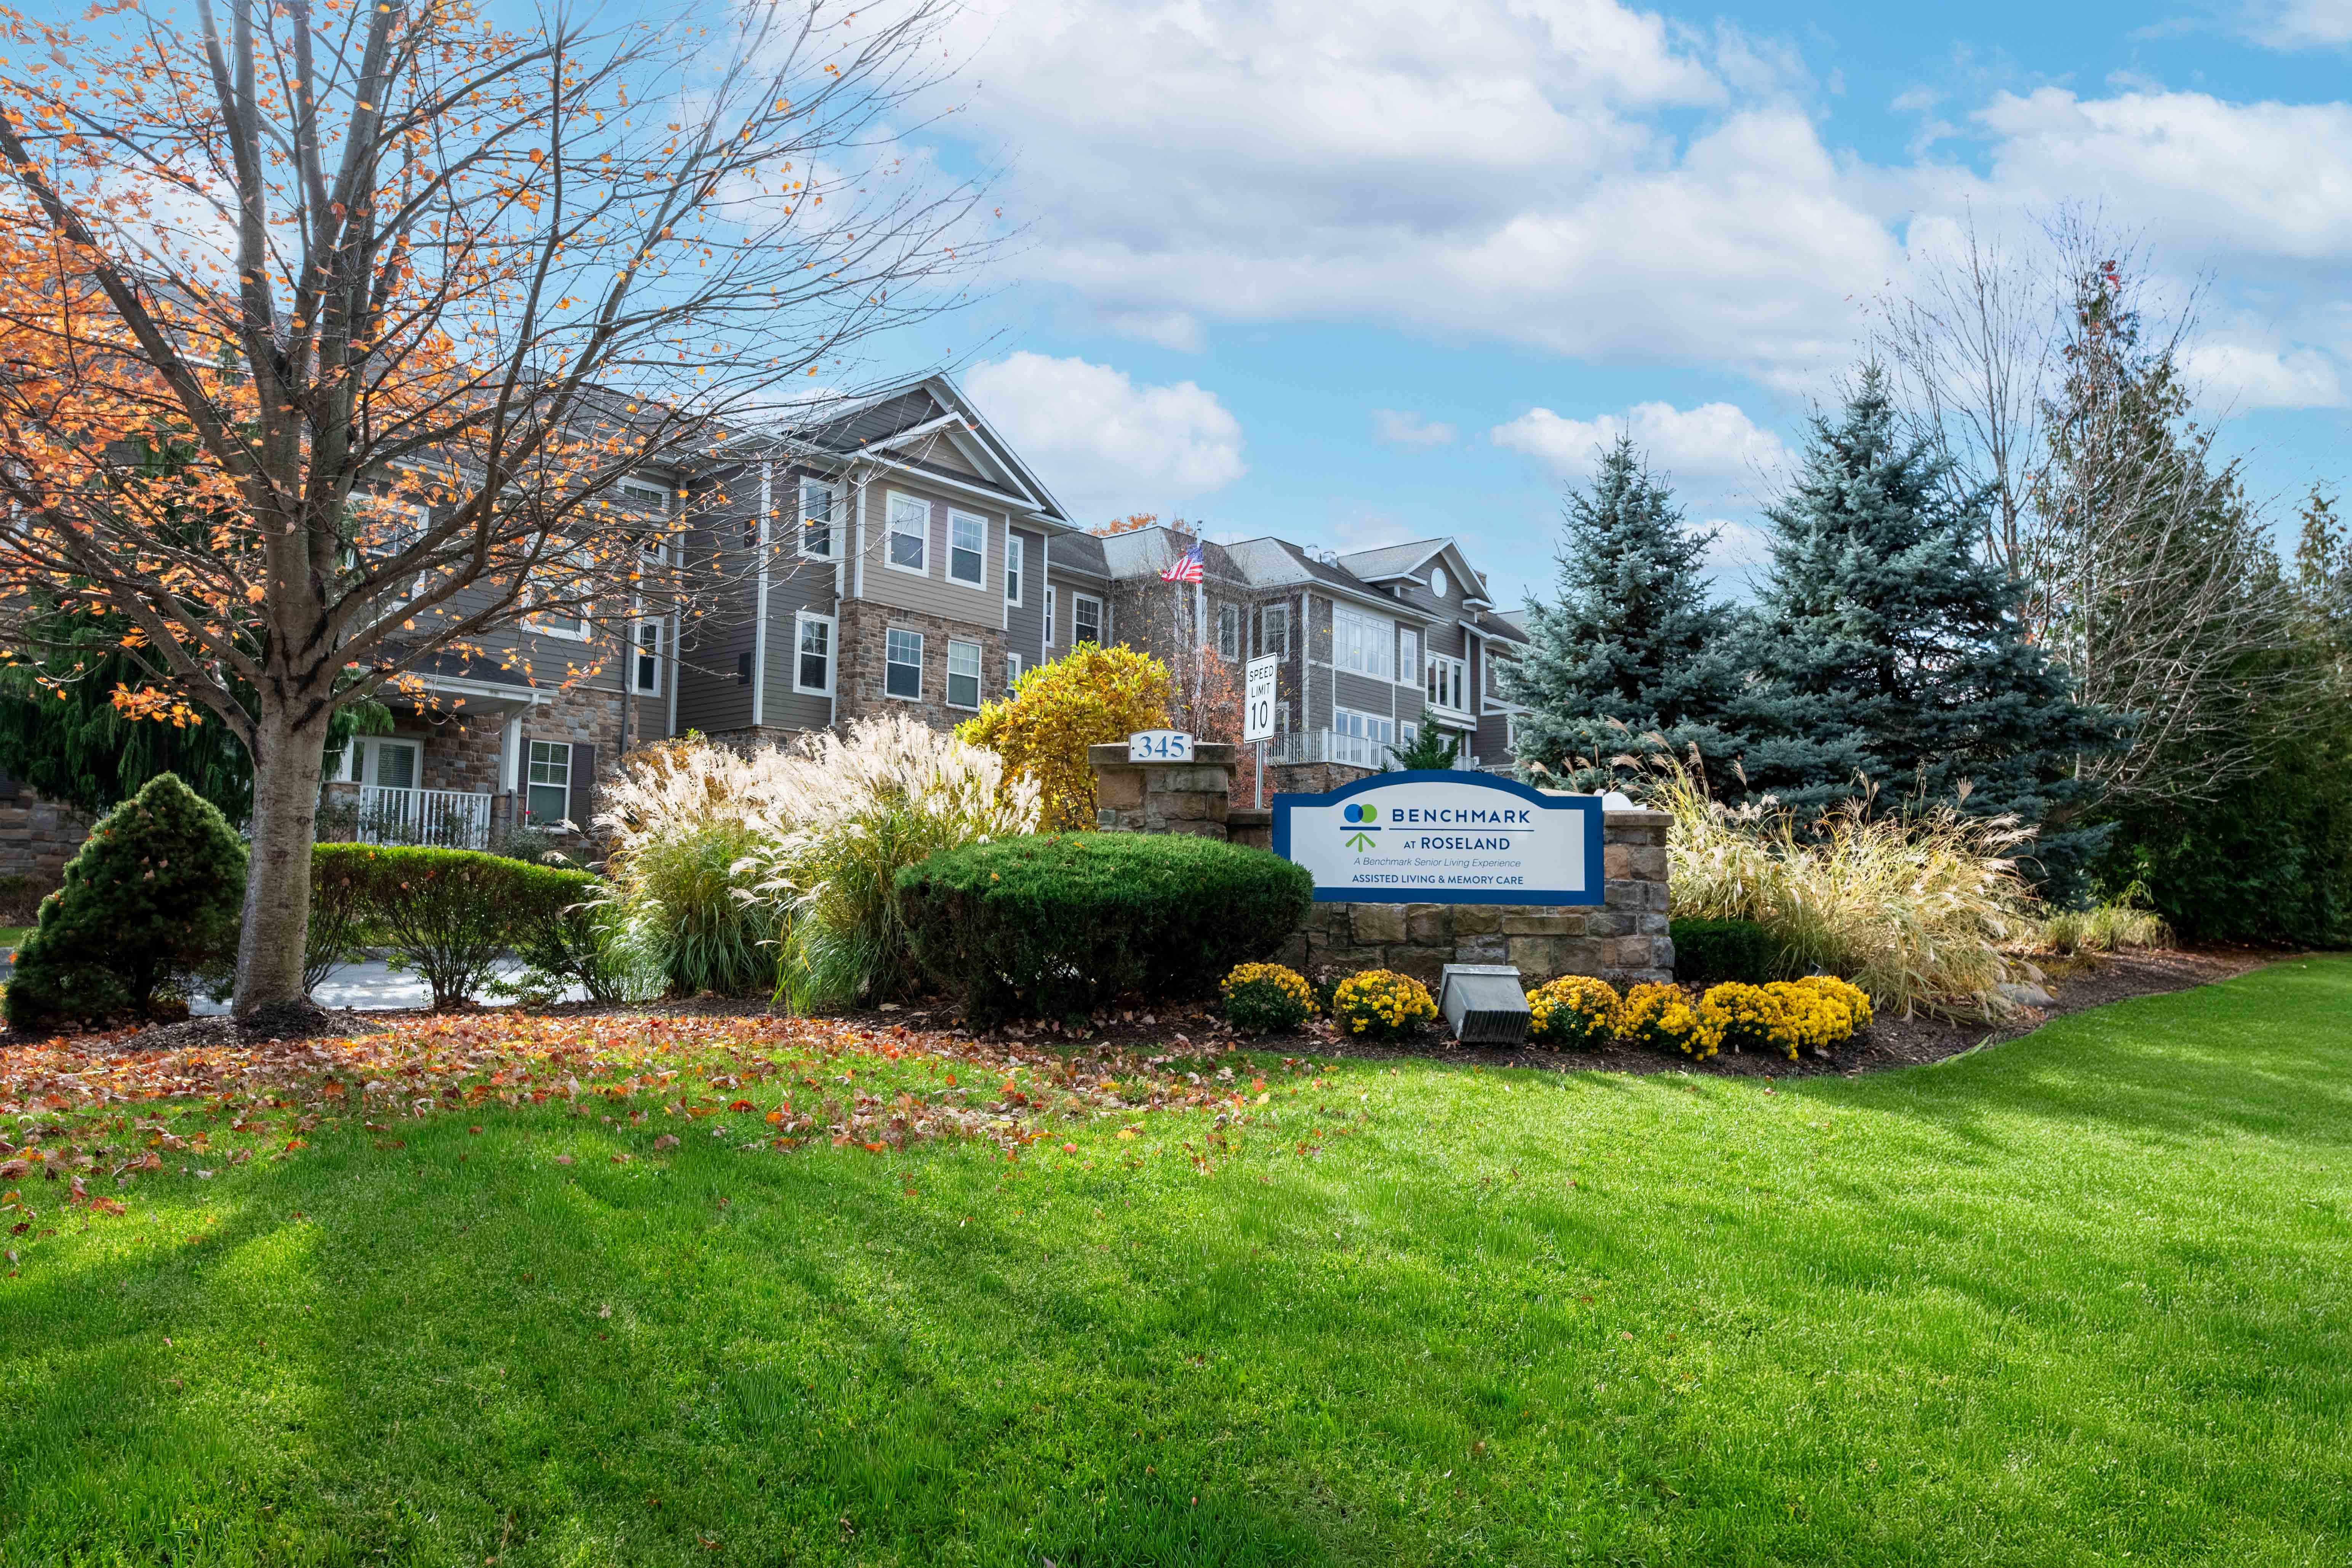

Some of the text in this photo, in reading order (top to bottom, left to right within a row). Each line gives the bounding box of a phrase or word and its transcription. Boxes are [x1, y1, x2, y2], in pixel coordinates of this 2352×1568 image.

[1249, 665, 1274, 682] SPEED
[1251, 682, 1270, 698] LIMIT
[1252, 700, 1267, 730] 10
[1138, 736, 1184, 758] 345
[1392, 809, 1530, 823] BENCHMARK
[1404, 837, 1510, 850] AT ROSELAND
[1354, 857, 1521, 869] A Benchmark Senior Living Experience
[1352, 874, 1523, 885] ASSISTED LIVING & MEMORY CARE
